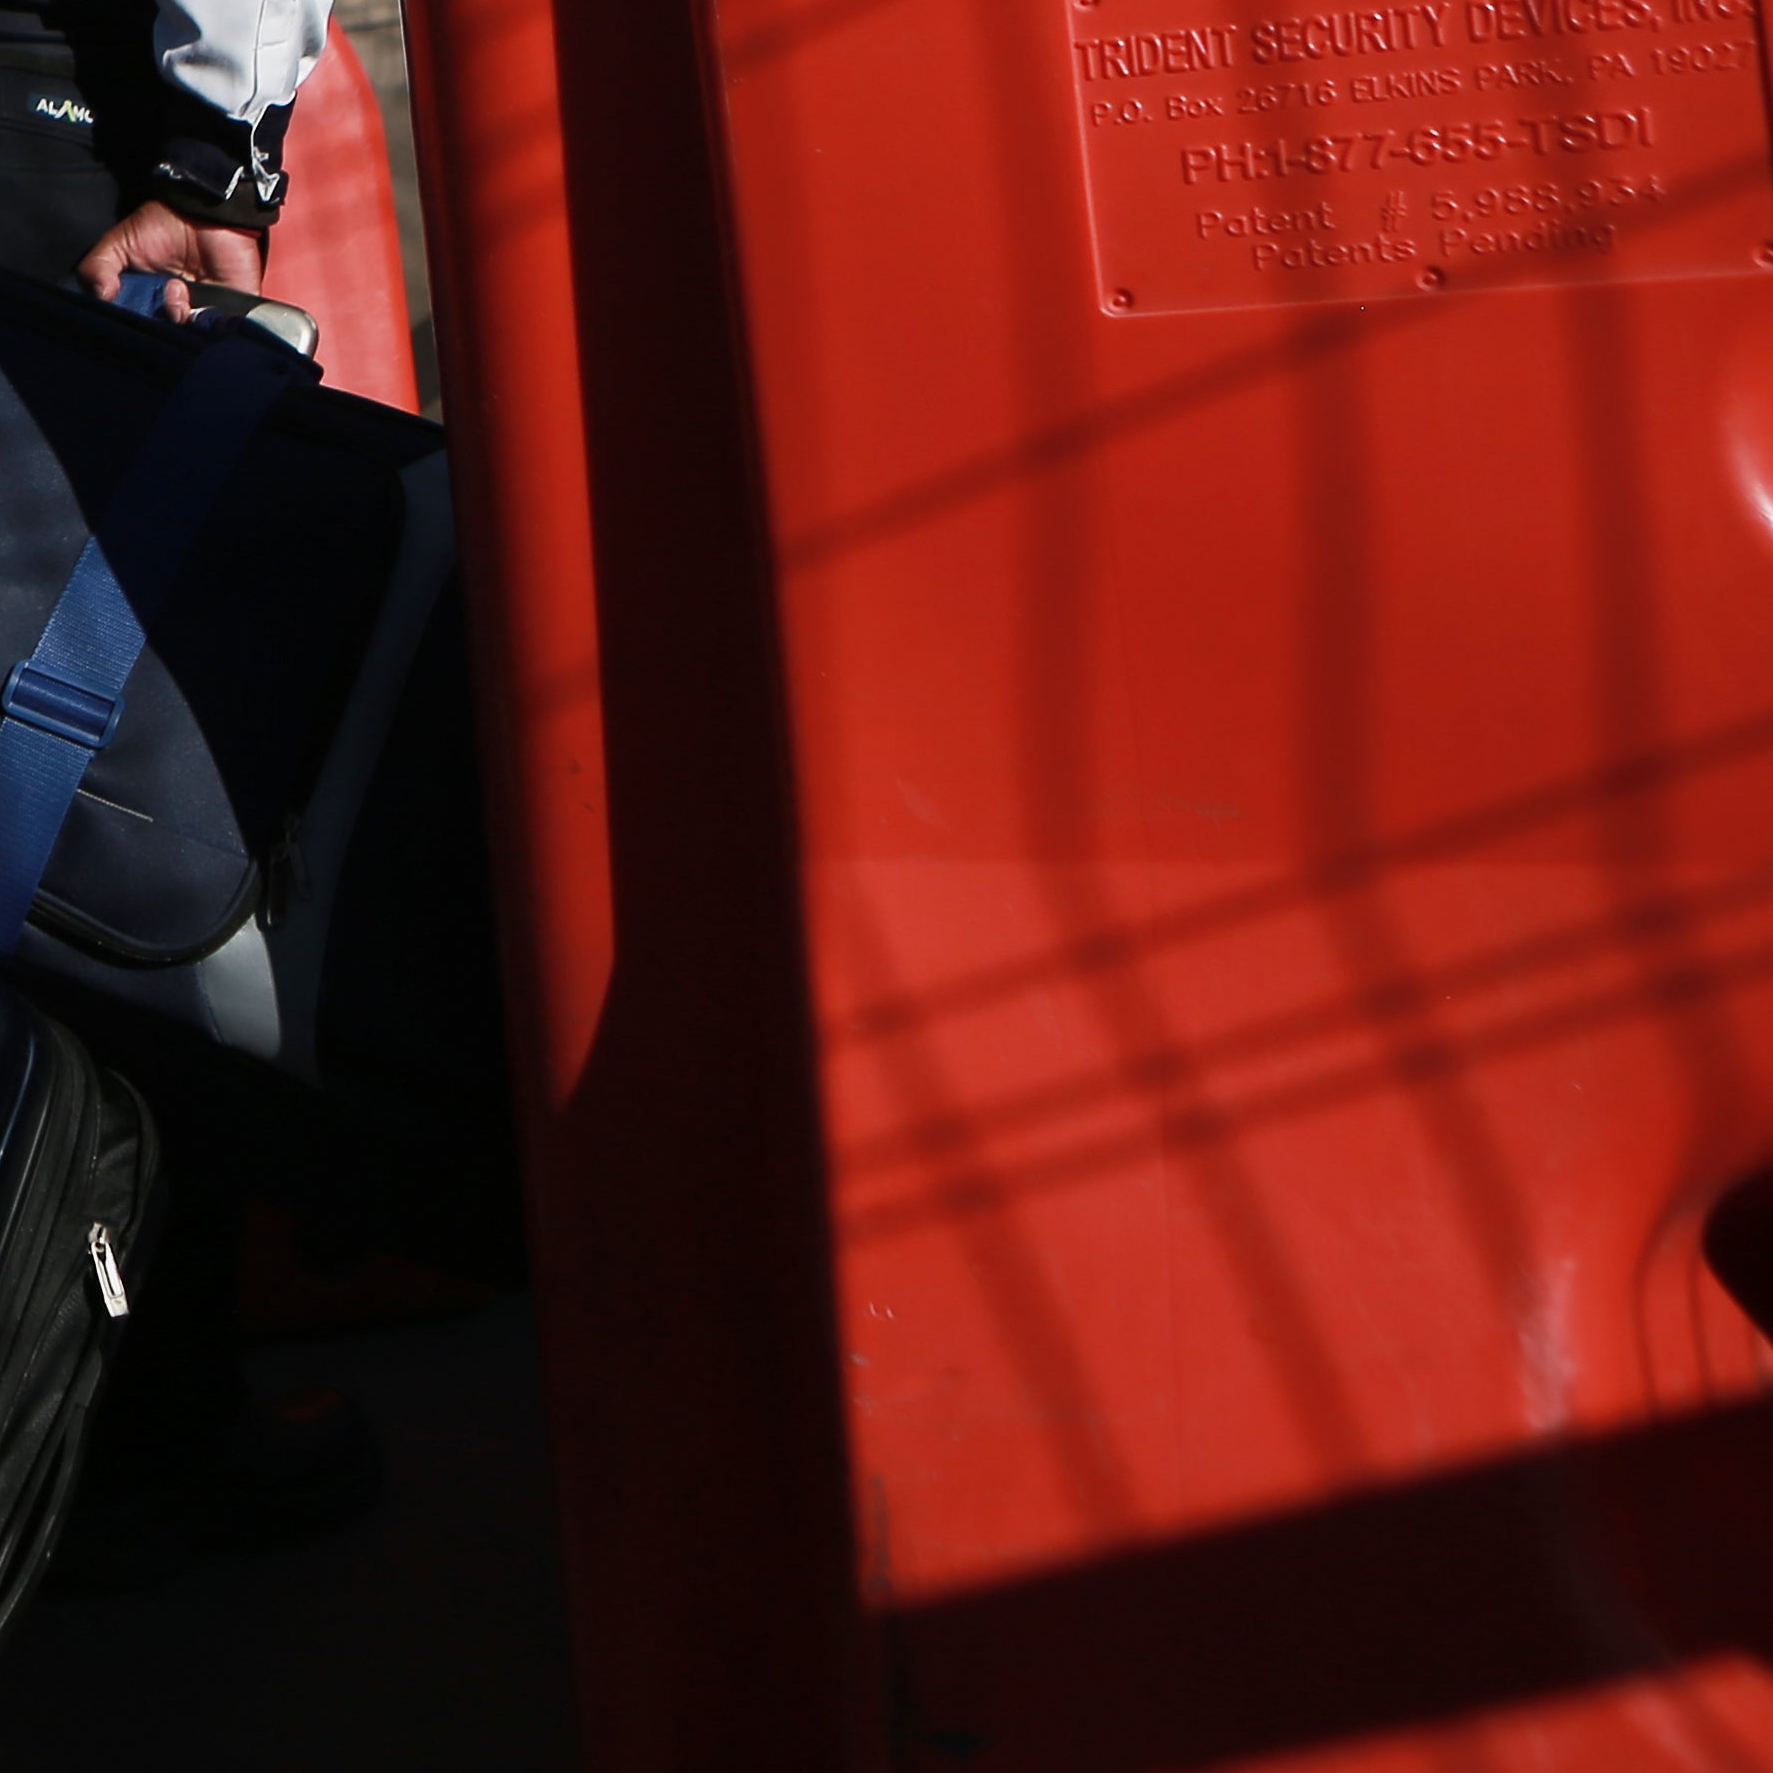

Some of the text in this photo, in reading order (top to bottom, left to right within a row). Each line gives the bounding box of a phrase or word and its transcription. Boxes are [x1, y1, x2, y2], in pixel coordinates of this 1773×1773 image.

[1074, 24, 1238, 81] TRIDENT
[1251, 3, 1450, 63] SECURITY
[1092, 98, 1153, 126] P.O.
[1166, 95, 1224, 120] Box
[1238, 79, 1337, 114] 26716
[1352, 68, 1461, 103] ELKINS
[1589, 53, 1636, 82] PA
[1651, 39, 1756, 76] 19027
[1197, 201, 1335, 240] Patent
[1381, 190, 1406, 232] #
[1253, 218, 1616, 271] Patents Pending
